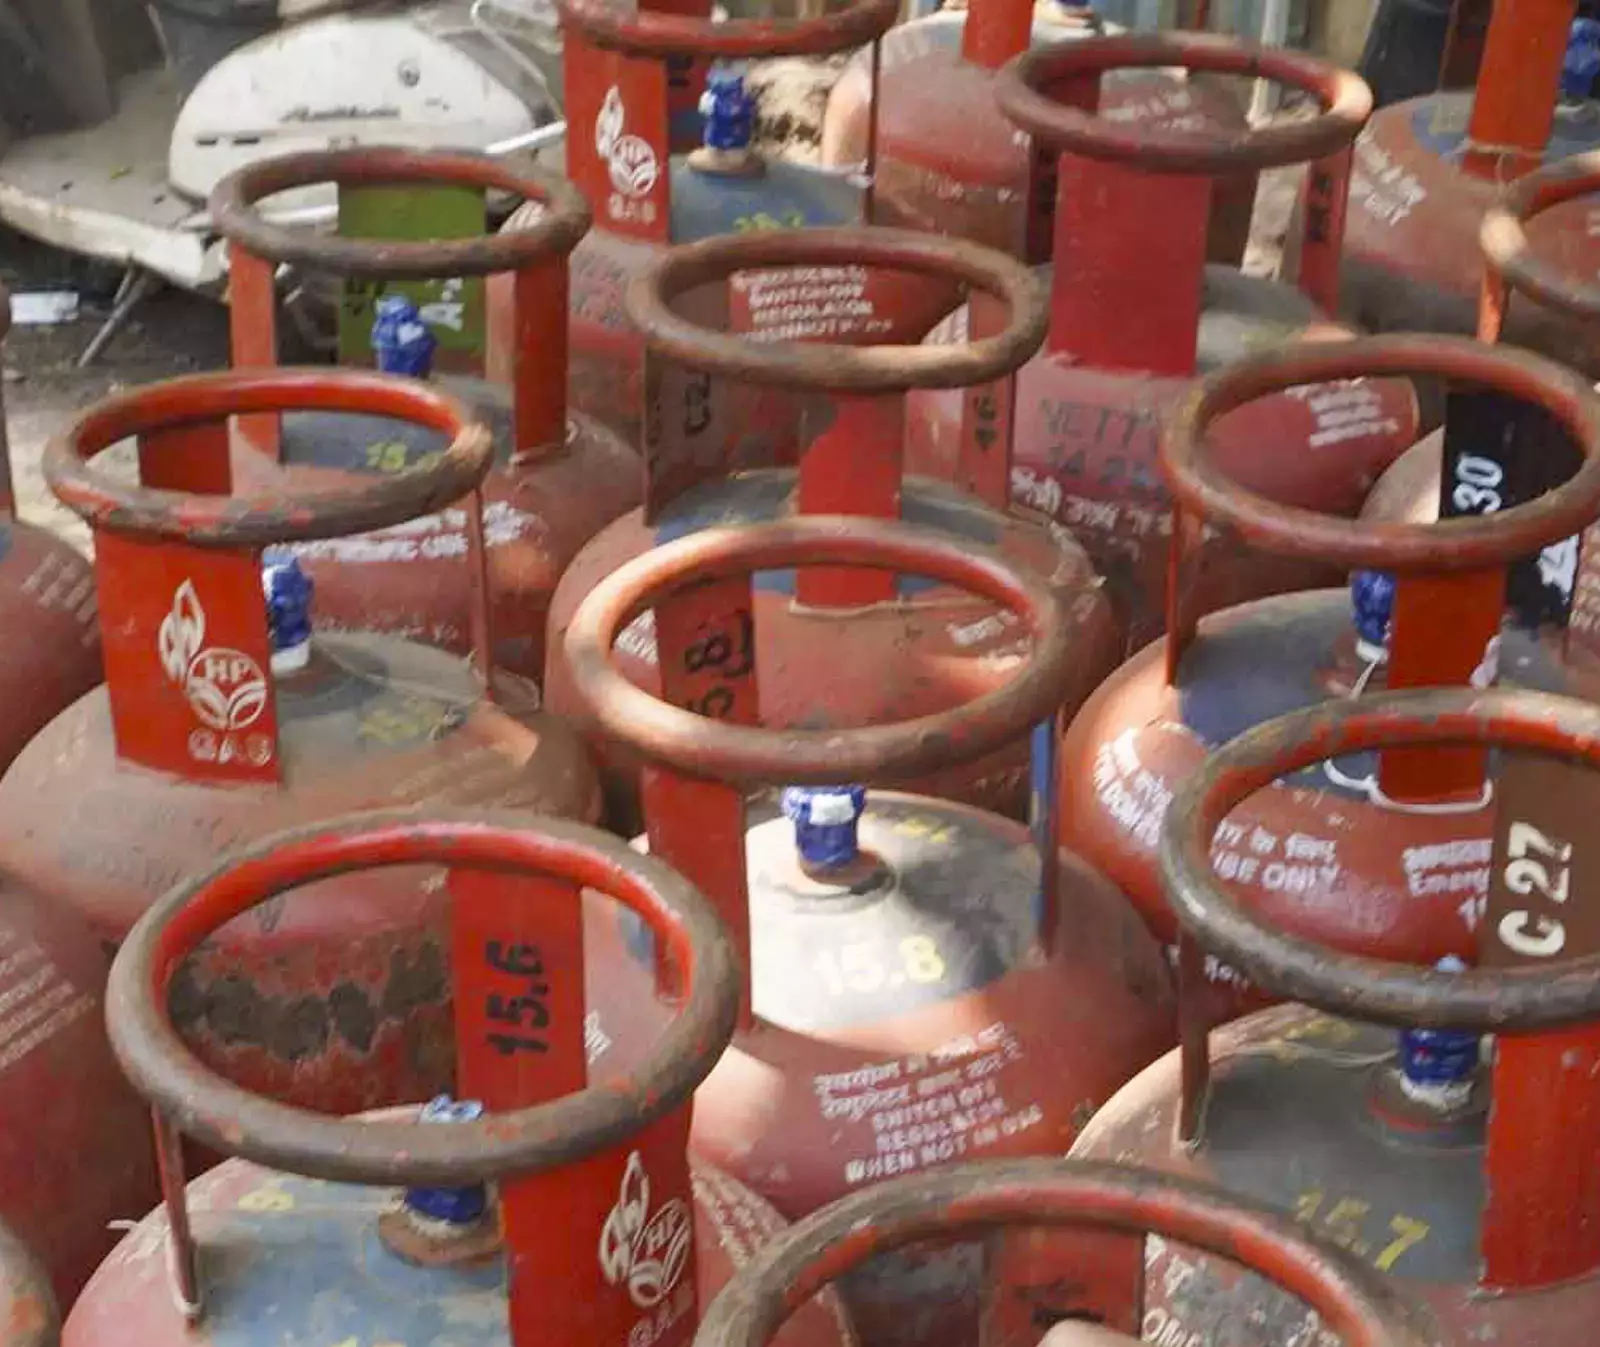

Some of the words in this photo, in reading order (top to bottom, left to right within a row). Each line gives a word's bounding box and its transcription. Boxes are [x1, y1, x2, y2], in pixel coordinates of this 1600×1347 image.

[204, 658, 249, 687] HP
[1504, 821, 1572, 903] 27
[1499, 909, 1566, 957] C
[813, 934, 945, 997] 15.8
[485, 939, 551, 1057] 15.6
[844, 1148, 918, 1185] WHEN
